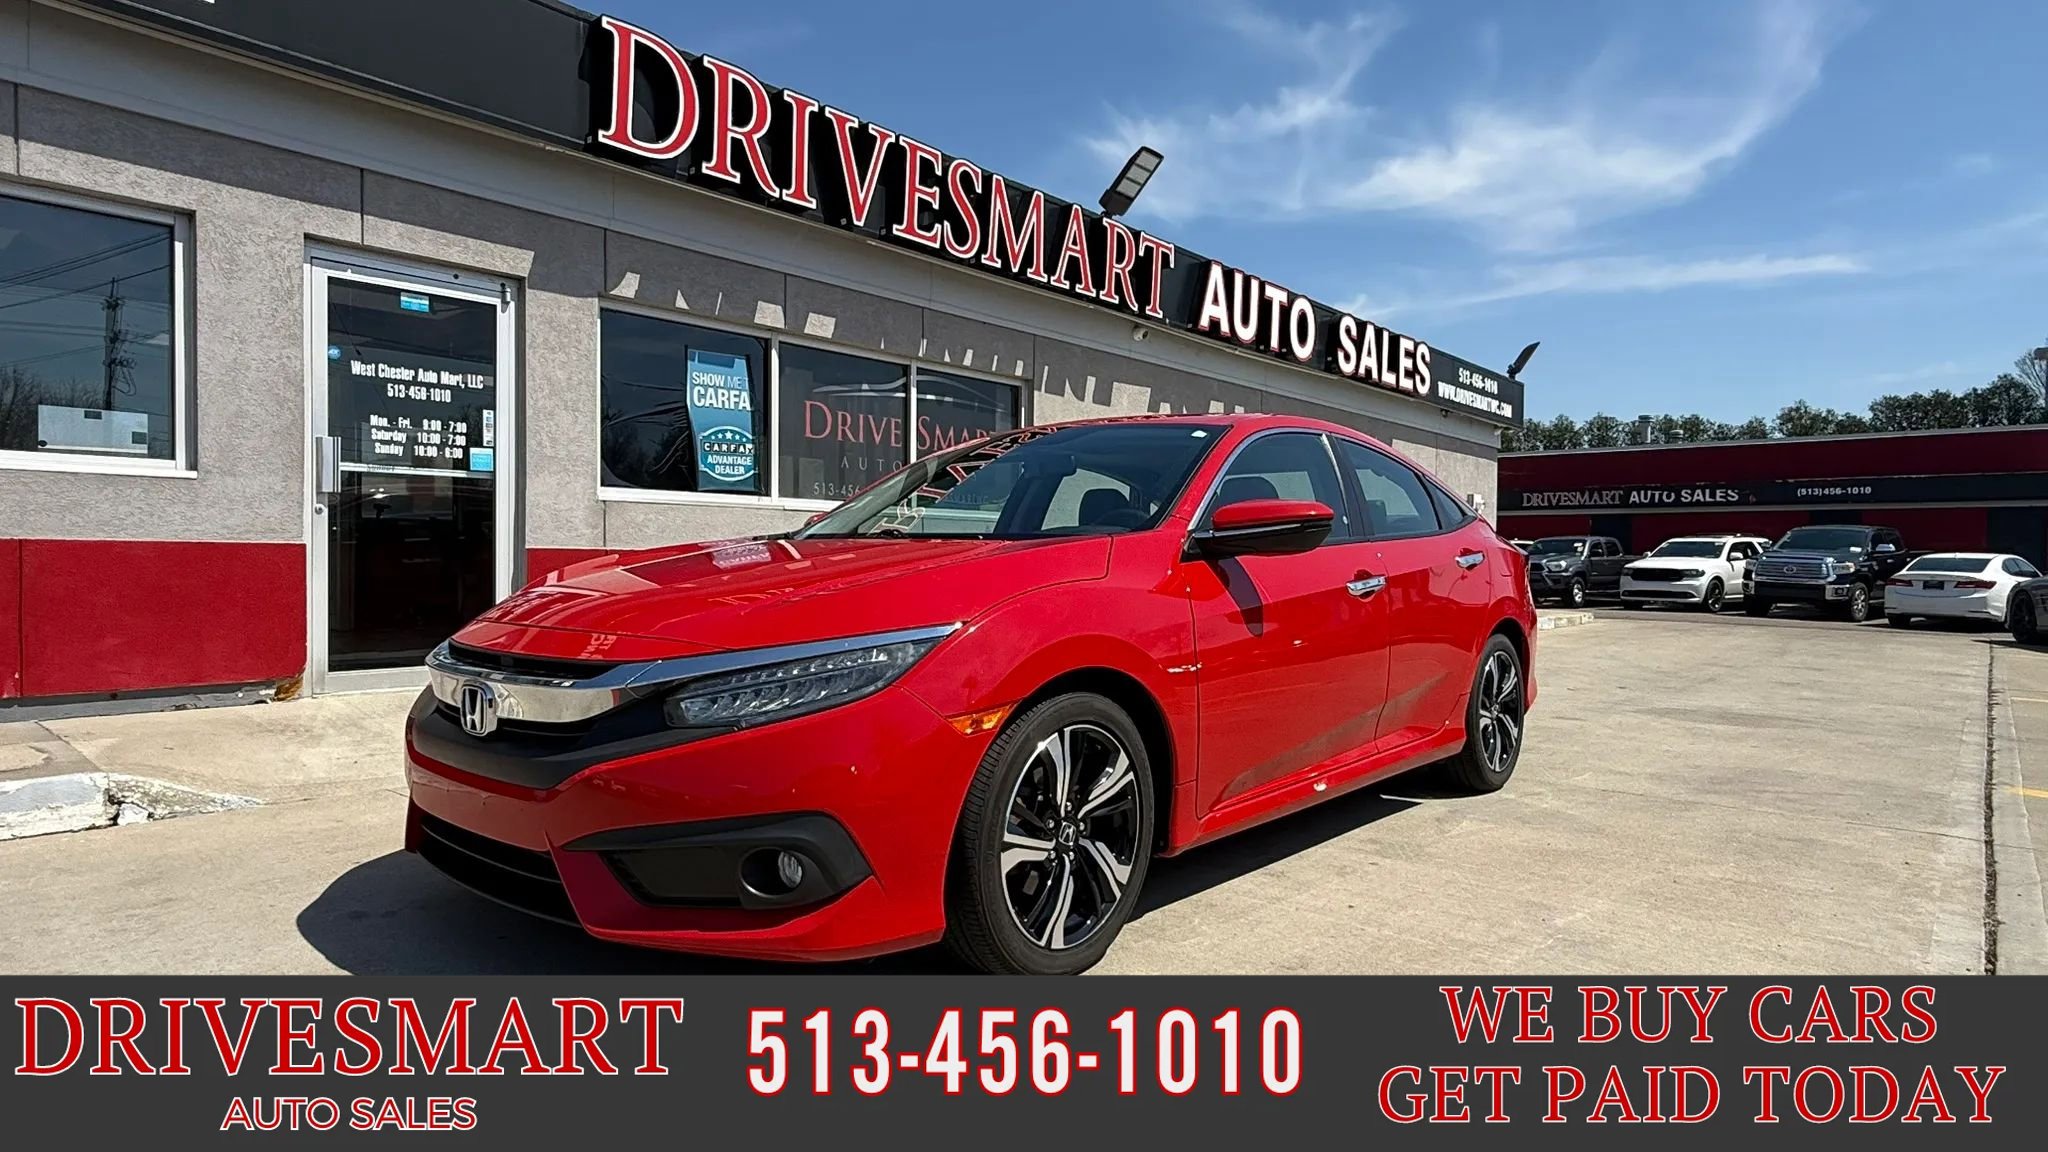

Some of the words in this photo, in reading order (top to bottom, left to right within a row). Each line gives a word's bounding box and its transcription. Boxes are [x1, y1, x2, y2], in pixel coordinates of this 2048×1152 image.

[598, 15, 1174, 318] DRIVESMART
[1198, 260, 1316, 362] AUTO
[1337, 313, 1431, 397] SALES
[350, 360, 376, 377] West
[378, 363, 416, 381] Chester
[417, 368, 438, 384] Auto
[440, 371, 465, 389] Mart,
[467, 374, 484, 389] LLC
[692, 371, 725, 388] SHOW
[727, 376, 741, 390] ME
[693, 386, 751, 411] CARFA
[371, 428, 407, 444] Saturday
[374, 442, 404, 457] Sunday
[704, 442, 753, 454] CARFAX
[707, 454, 752, 466] ADVANTAGE
[714, 464, 745, 475] DEALER
[1522, 490, 1624, 507] DRIVESMART
[1629, 490, 1675, 505] AUTO
[1680, 488, 1740, 503] SALES
